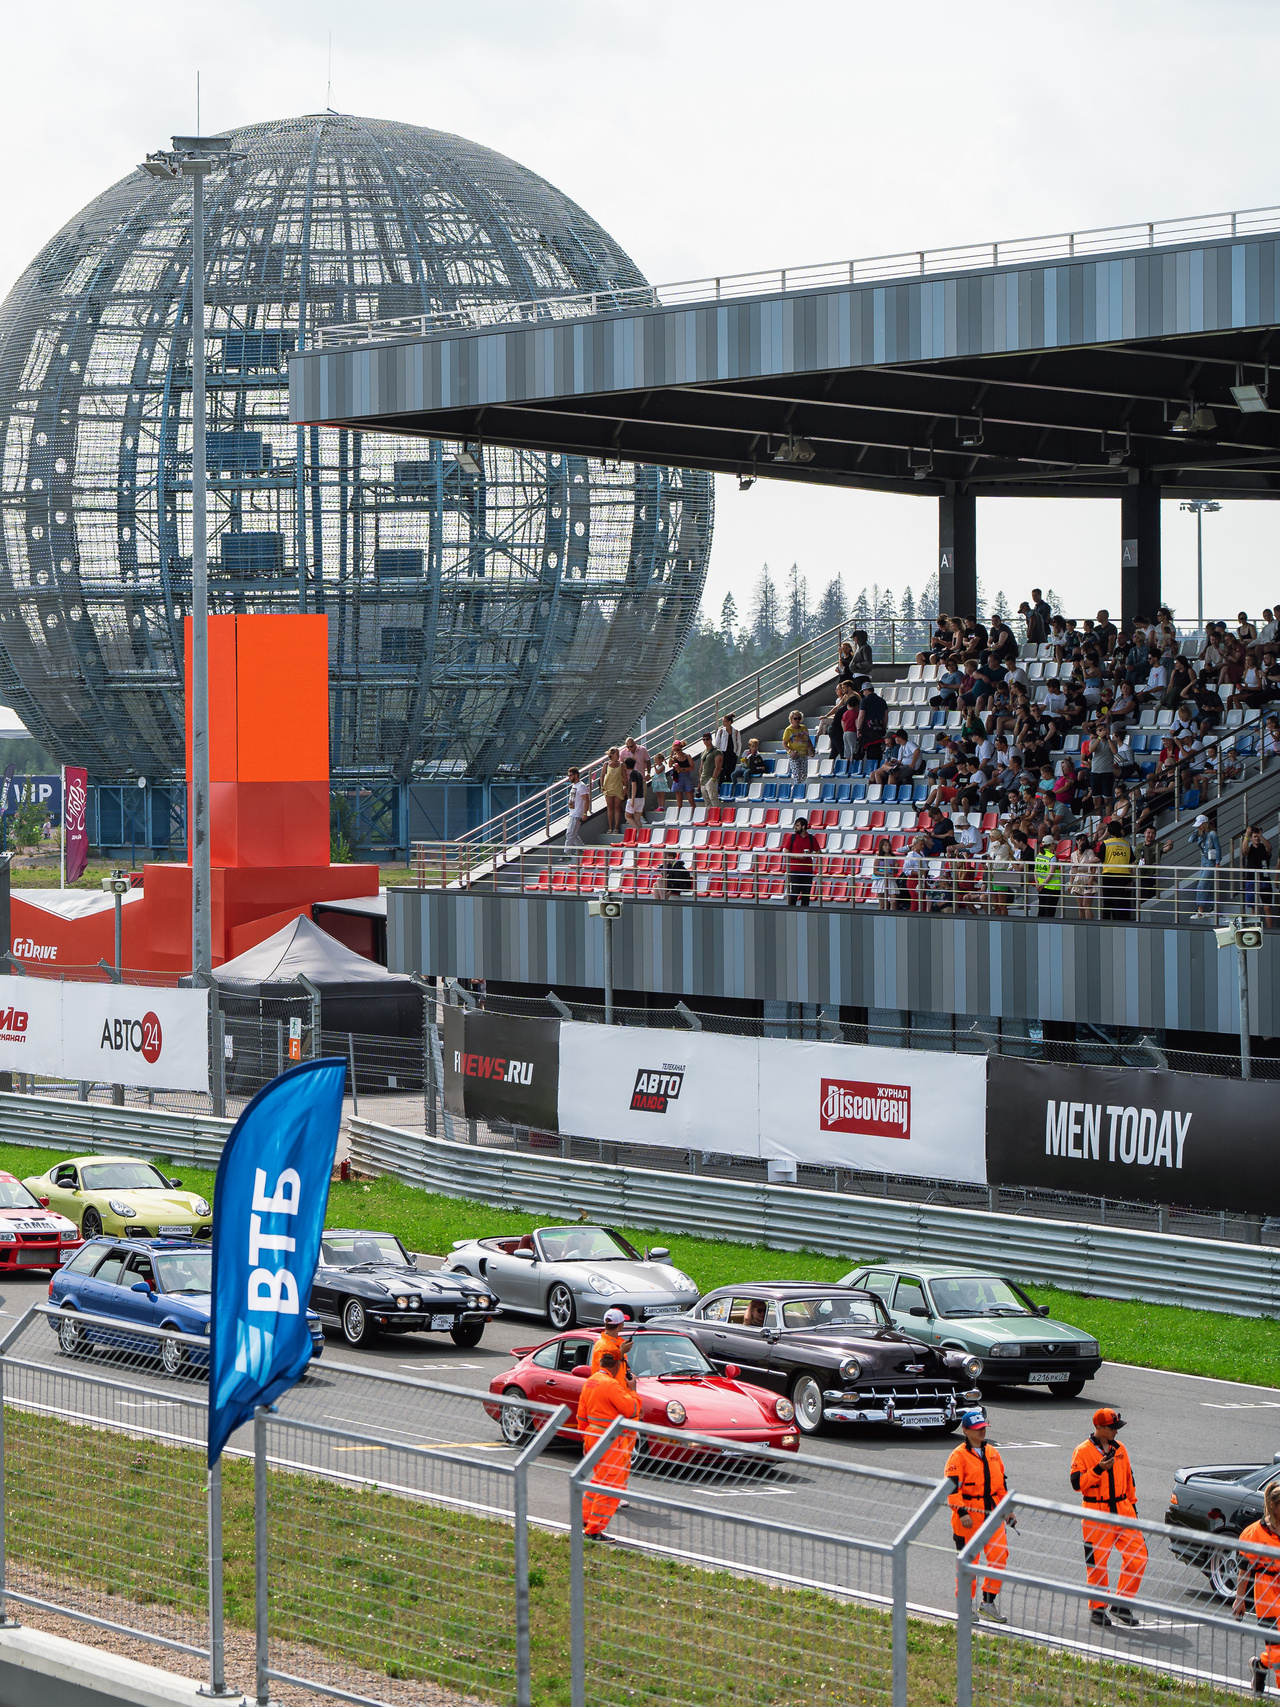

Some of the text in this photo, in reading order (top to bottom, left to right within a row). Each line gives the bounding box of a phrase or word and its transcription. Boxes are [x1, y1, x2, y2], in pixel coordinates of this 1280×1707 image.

[13, 783, 53, 803] VIP
[292, 1041, 298, 1057] F
[662, 1062, 686, 1072] ТЕЛЕКАНАЛ
[635, 1072, 681, 1096] АВТО
[877, 1087, 908, 1099] ЖУРНАЛ
[632, 1095, 665, 1110] ПЛЮС
[1045, 1100, 1193, 1169] MEN TODAY
[247, 1167, 301, 1315] ВТБ
[905, 1416, 940, 1424] АВТОКУЛЬТУРА
